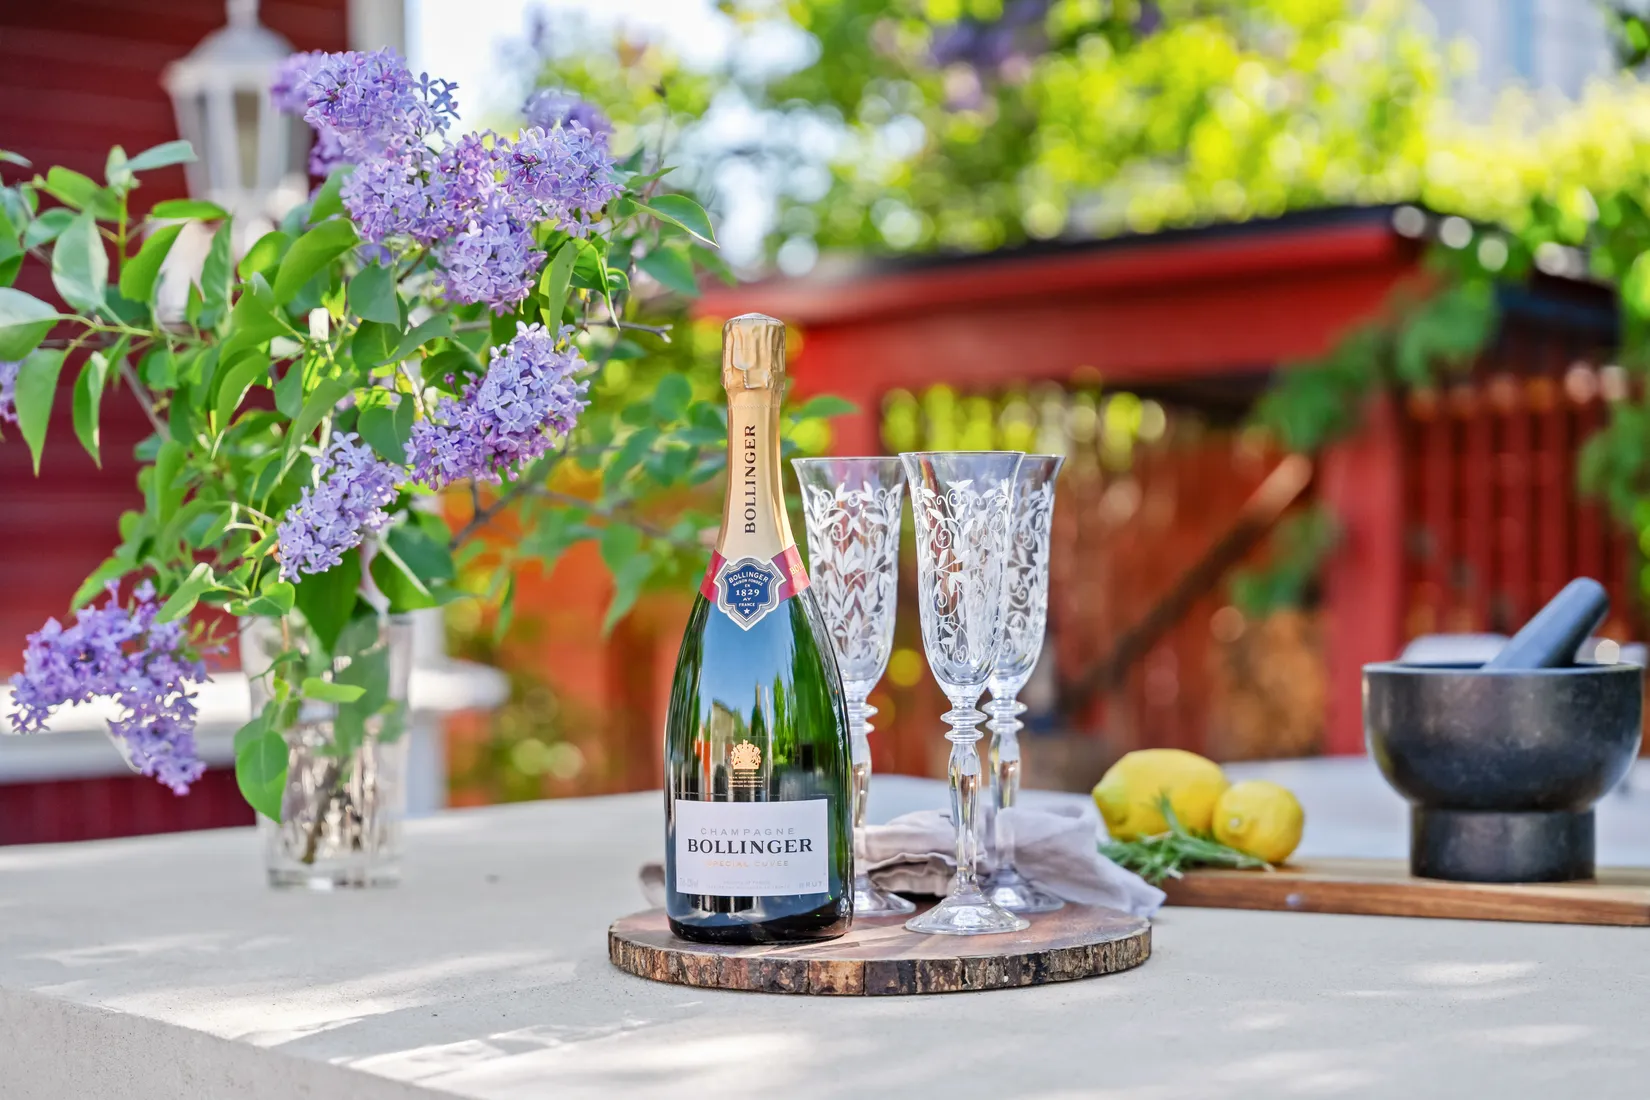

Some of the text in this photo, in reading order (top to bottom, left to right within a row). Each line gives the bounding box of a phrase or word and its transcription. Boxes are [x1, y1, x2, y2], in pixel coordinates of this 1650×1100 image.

[745, 424, 756, 534] BOLLINGER
[728, 571, 769, 584] BOLLINGER
[735, 589, 760, 597] 1829
[700, 827, 796, 837] CHAMPAGNE
[688, 838, 813, 854] BOLLINGER
